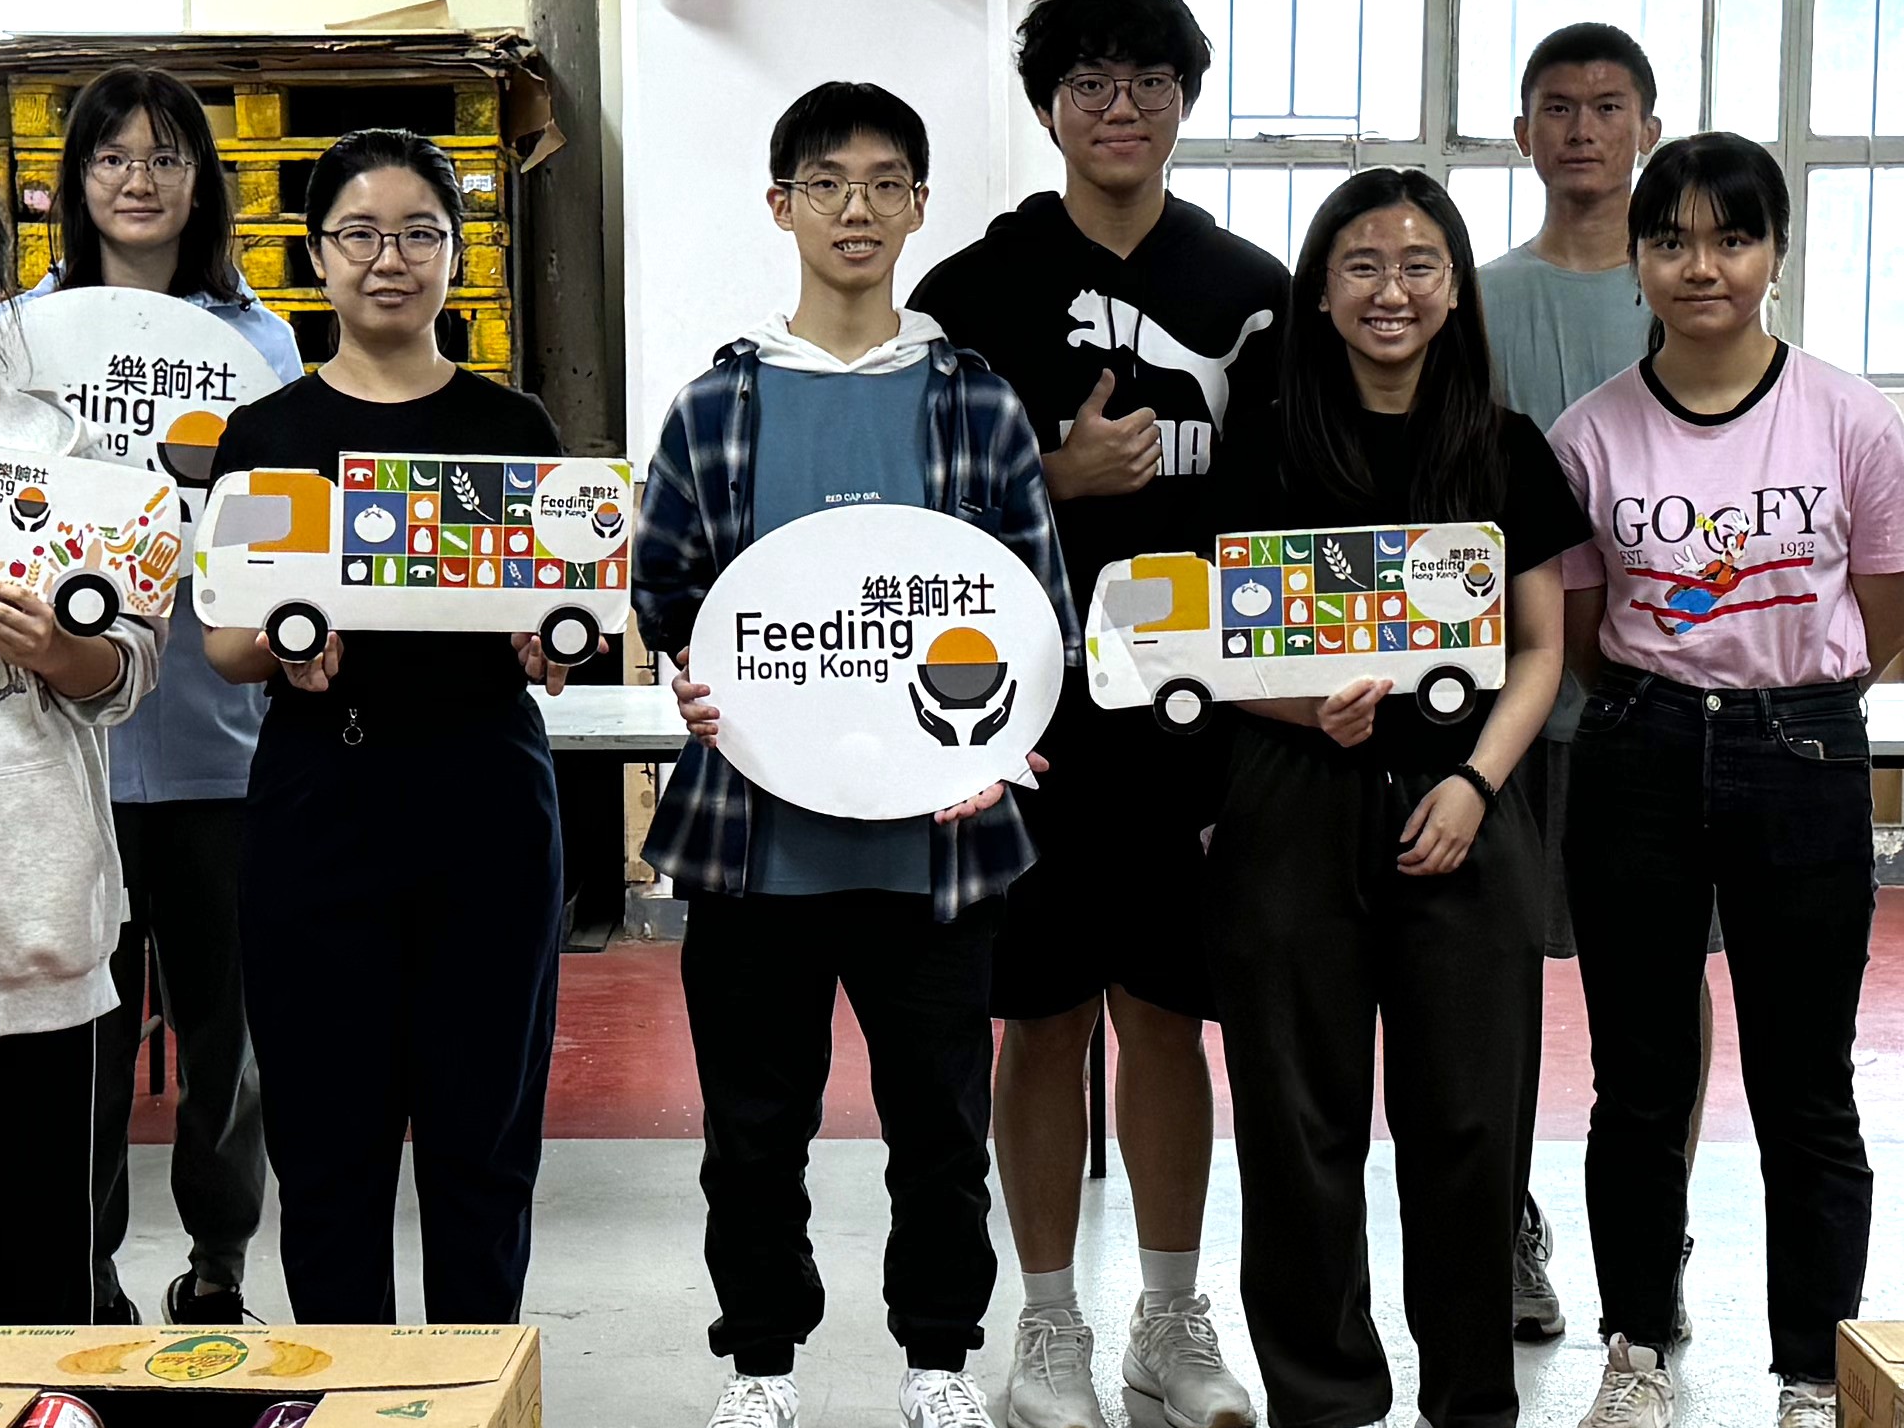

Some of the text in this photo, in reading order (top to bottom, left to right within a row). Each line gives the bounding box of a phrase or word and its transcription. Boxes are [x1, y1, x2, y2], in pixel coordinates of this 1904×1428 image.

[106, 354, 236, 402] 樂餉社
[540, 495, 595, 512] Feeding
[1779, 540, 1815, 557] 1932
[1411, 558, 1465, 573] Feeding
[861, 573, 996, 617] 樂餉社
[736, 610, 914, 659] Feeding
[737, 653, 889, 685] Hong Kong
